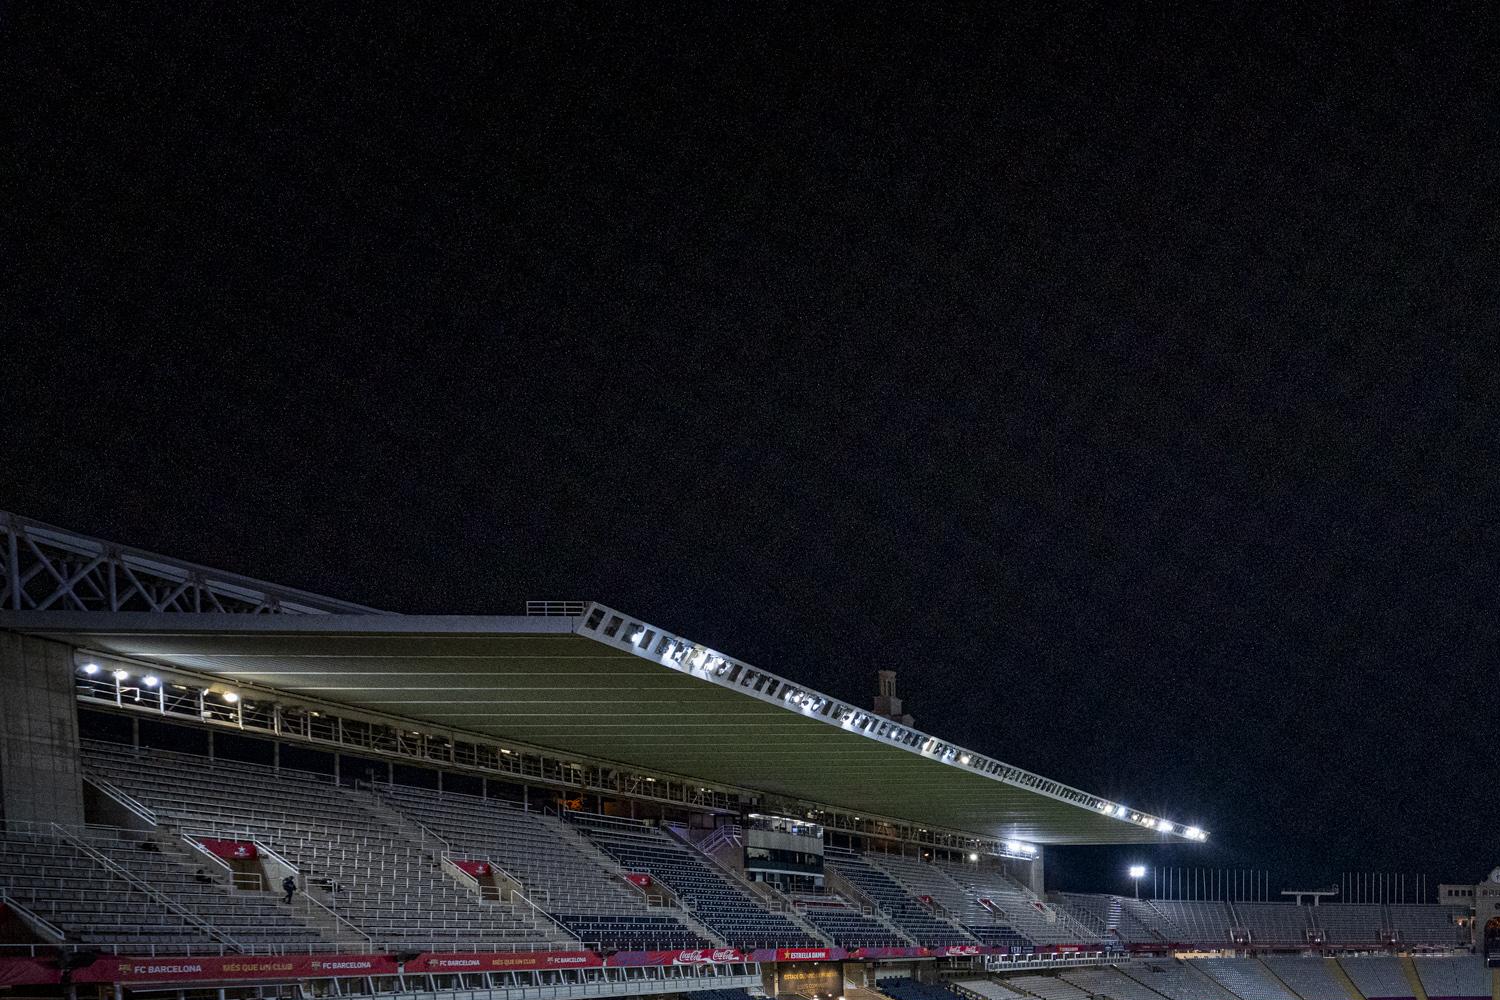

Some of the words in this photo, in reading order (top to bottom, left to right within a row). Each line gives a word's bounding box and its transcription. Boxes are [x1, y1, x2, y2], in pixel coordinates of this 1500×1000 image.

[680, 950, 703, 962] Coca-Cola
[712, 949, 735, 961] Coca-Cola
[332, 961, 371, 969] BARCELONA
[447, 959, 480, 967] BARCELONA
[134, 966, 146, 974] FC
[148, 965, 202, 974] BARCELONA
[242, 963, 259, 973] QUE
[273, 963, 294, 971] CLUB
